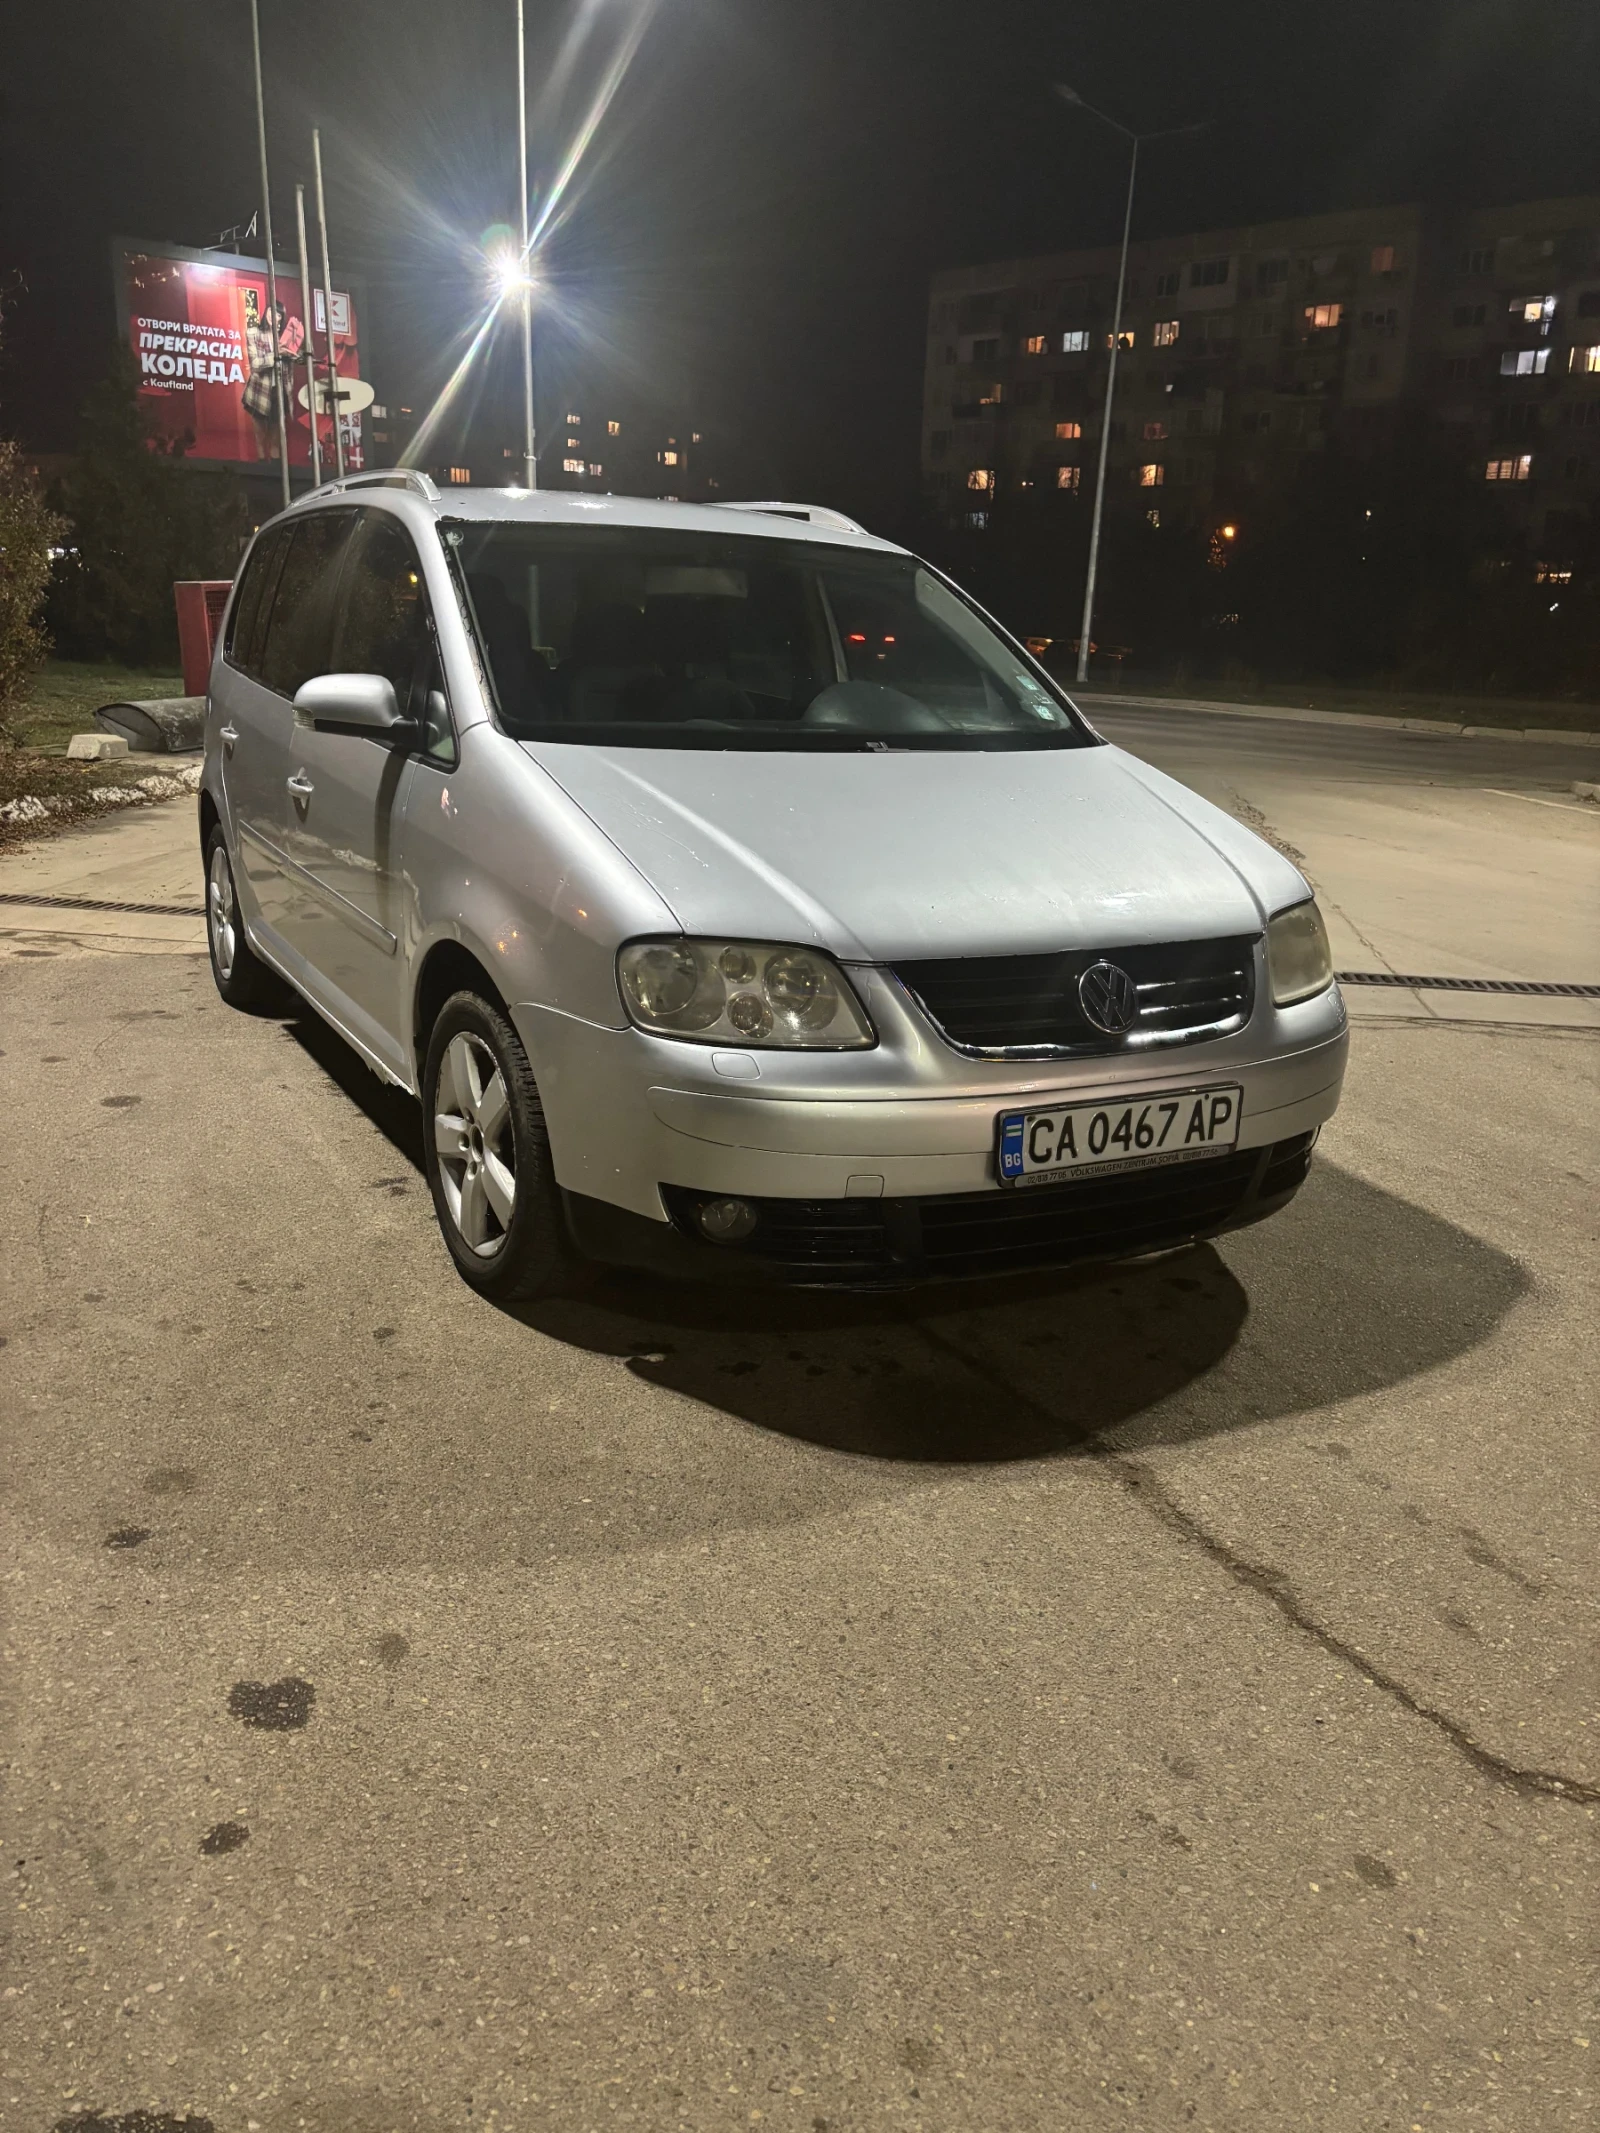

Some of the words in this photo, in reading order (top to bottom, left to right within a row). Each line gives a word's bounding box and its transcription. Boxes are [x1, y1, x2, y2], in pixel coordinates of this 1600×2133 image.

[137, 317, 181, 332] ОТВОРИ
[182, 323, 226, 339] ВРАТАТА
[228, 329, 242, 341] ЗА
[139, 332, 243, 360] ПРЕКРАСНА
[140, 352, 246, 386] КОЛЕДА
[150, 378, 194, 391] Kaufland
[1028, 1115, 1078, 1164] CA
[1087, 1102, 1180, 1156] 0467
[1184, 1096, 1233, 1144] AP
[1004, 1152, 1022, 1168] BG
[1070, 1163, 1122, 1178] VOLKSWAGEN
